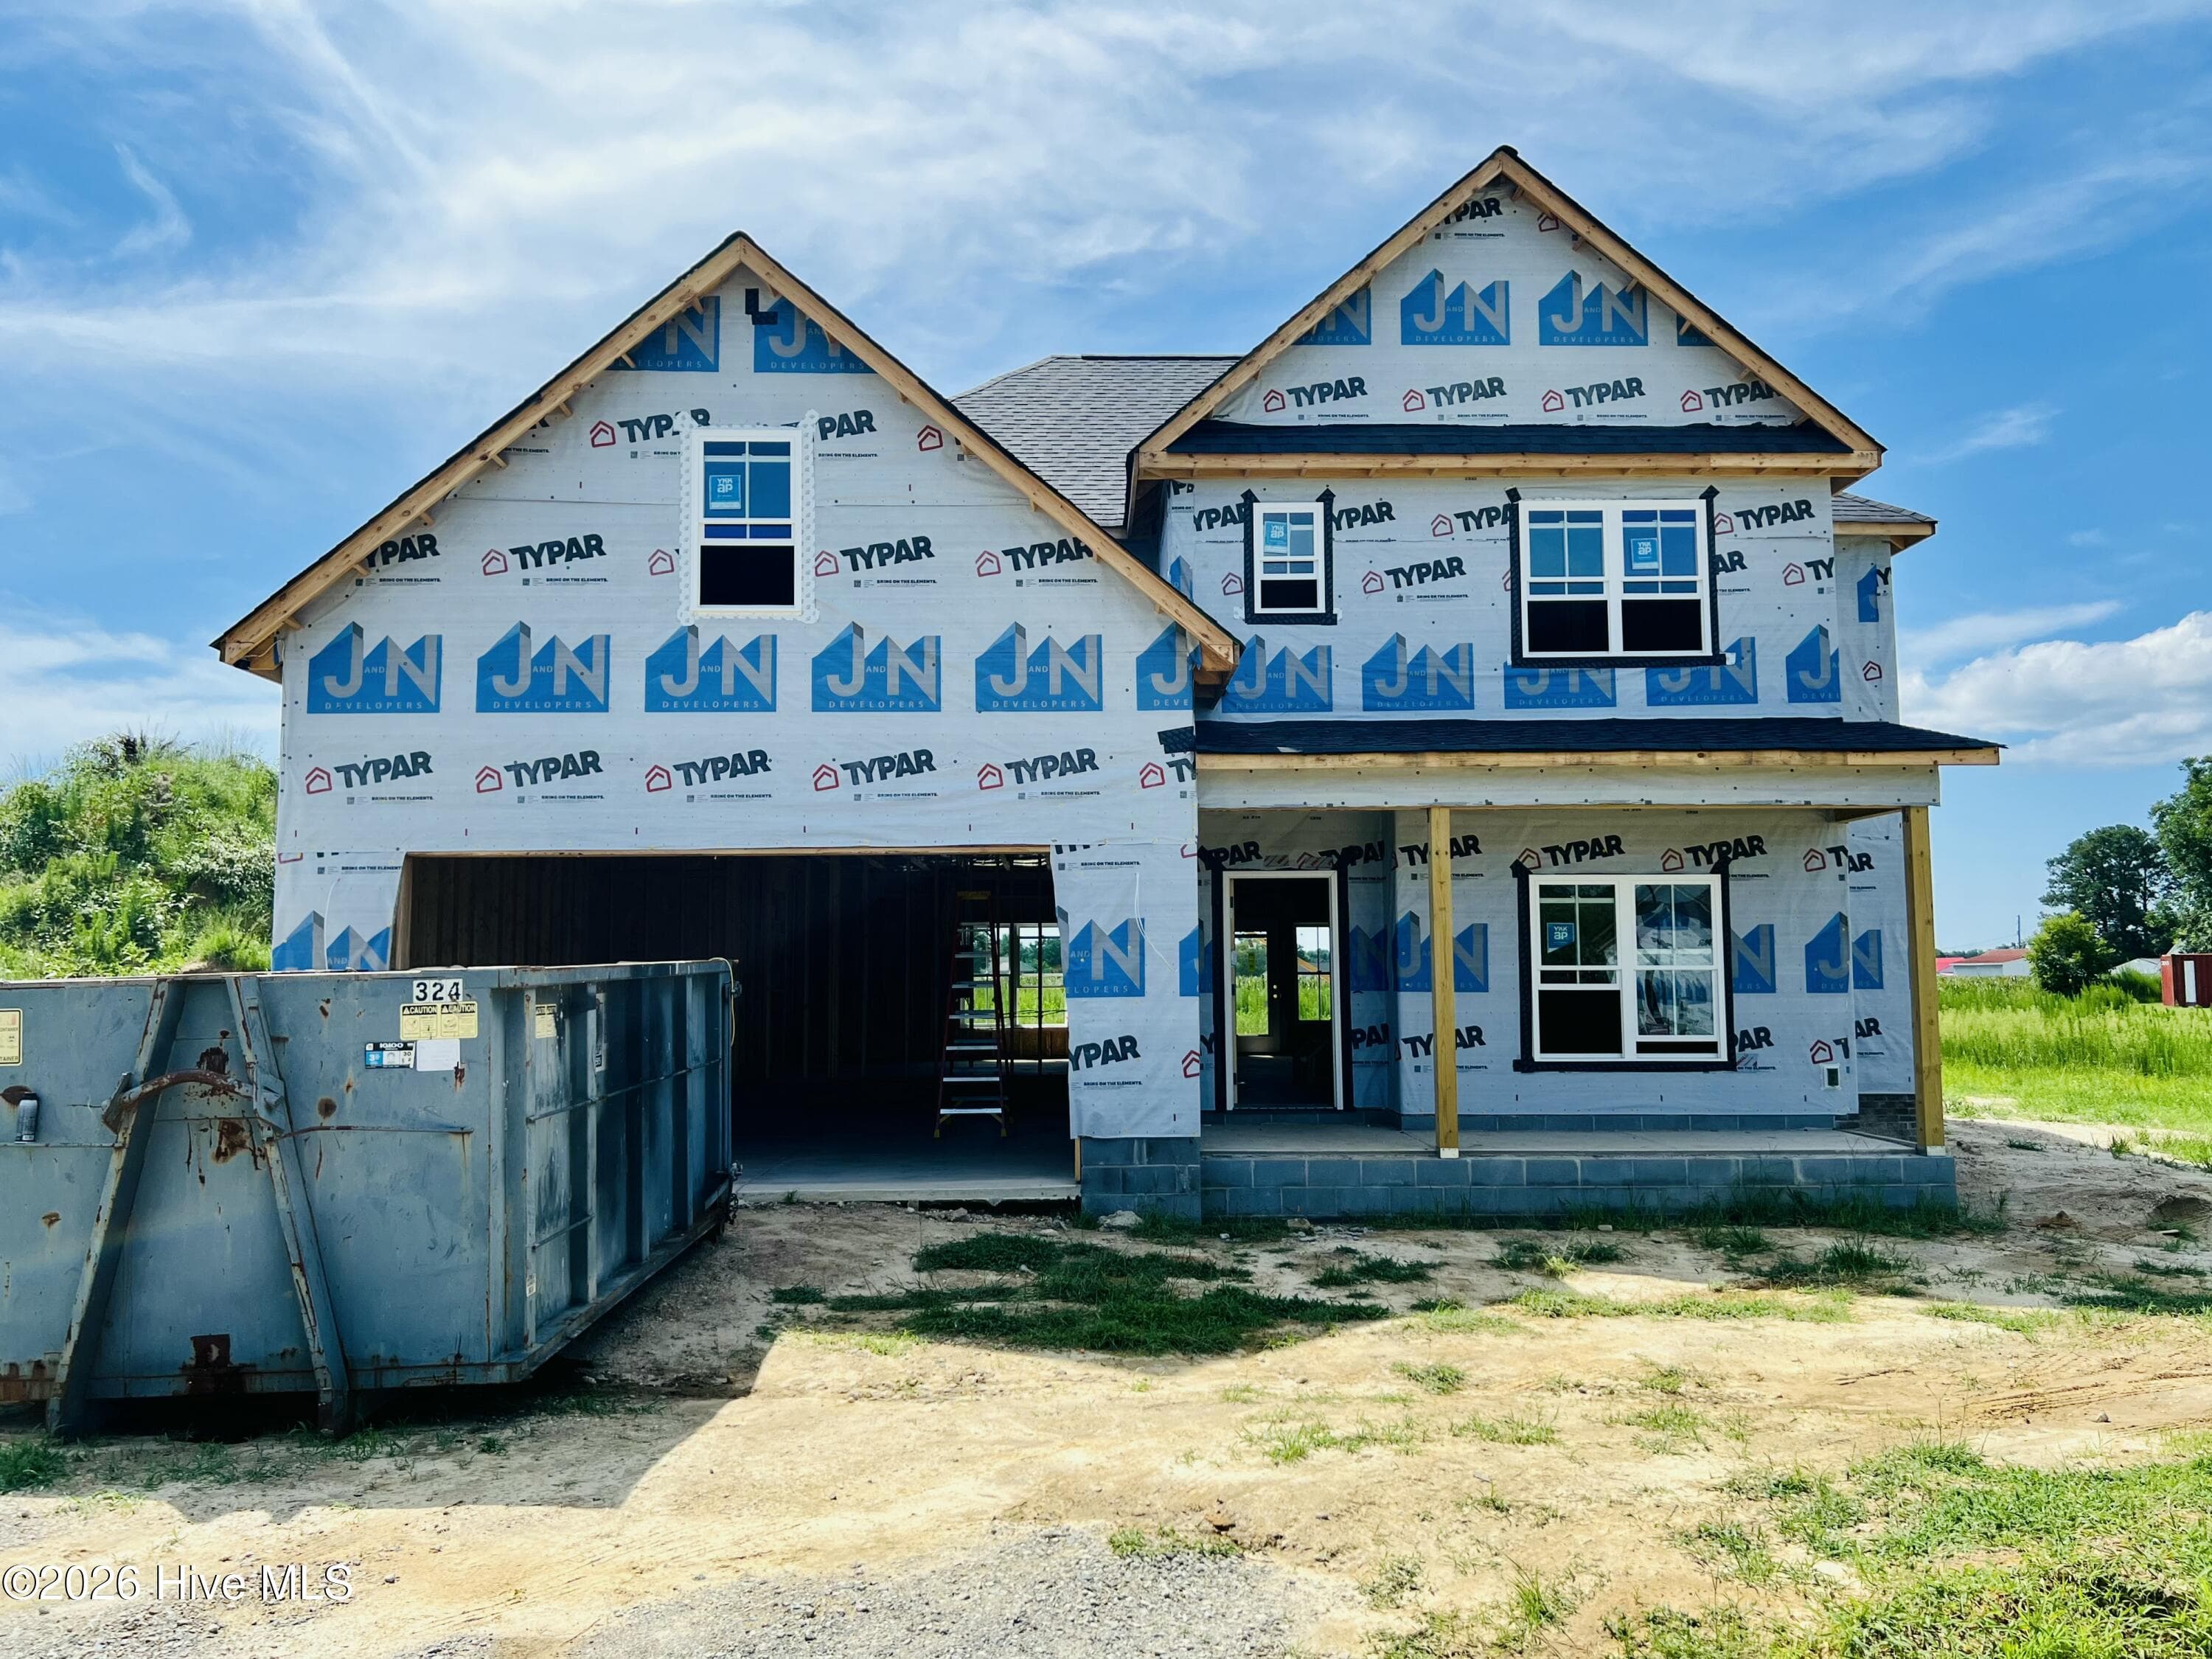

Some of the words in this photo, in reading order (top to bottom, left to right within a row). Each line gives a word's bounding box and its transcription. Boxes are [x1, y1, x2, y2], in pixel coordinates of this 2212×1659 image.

[1286, 377, 1368, 408] TYPAR
[1425, 377, 1507, 408] TYPAR
[1565, 378, 1646, 408] TYPAR
[1332, 501, 1396, 531] YPAR
[1734, 500, 1815, 530] TYPAR
[367, 534, 440, 568] YPAR
[509, 534, 606, 570] TYPAR
[840, 536, 935, 571] TYPAR
[1385, 557, 1467, 588] TYPAR
[324, 701, 422, 709] DEVELOPERS
[493, 700, 591, 709] DEVELOPERS
[335, 751, 433, 788] TYPAR
[505, 751, 603, 787] TYPAR
[673, 750, 771, 786] TYPAR
[840, 749, 936, 785] TYPAR
[1004, 748, 1099, 784] TYPAR
[1541, 835, 1625, 866] TYPAR
[1683, 835, 1767, 866] TYPAR
[416, 982, 461, 1001] 324
[1066, 986, 1128, 994] ELOPERS
[409, 1006, 437, 1015] CAUTION
[448, 1005, 476, 1013] CAUTION
[1068, 1035, 1141, 1071] YPAR
